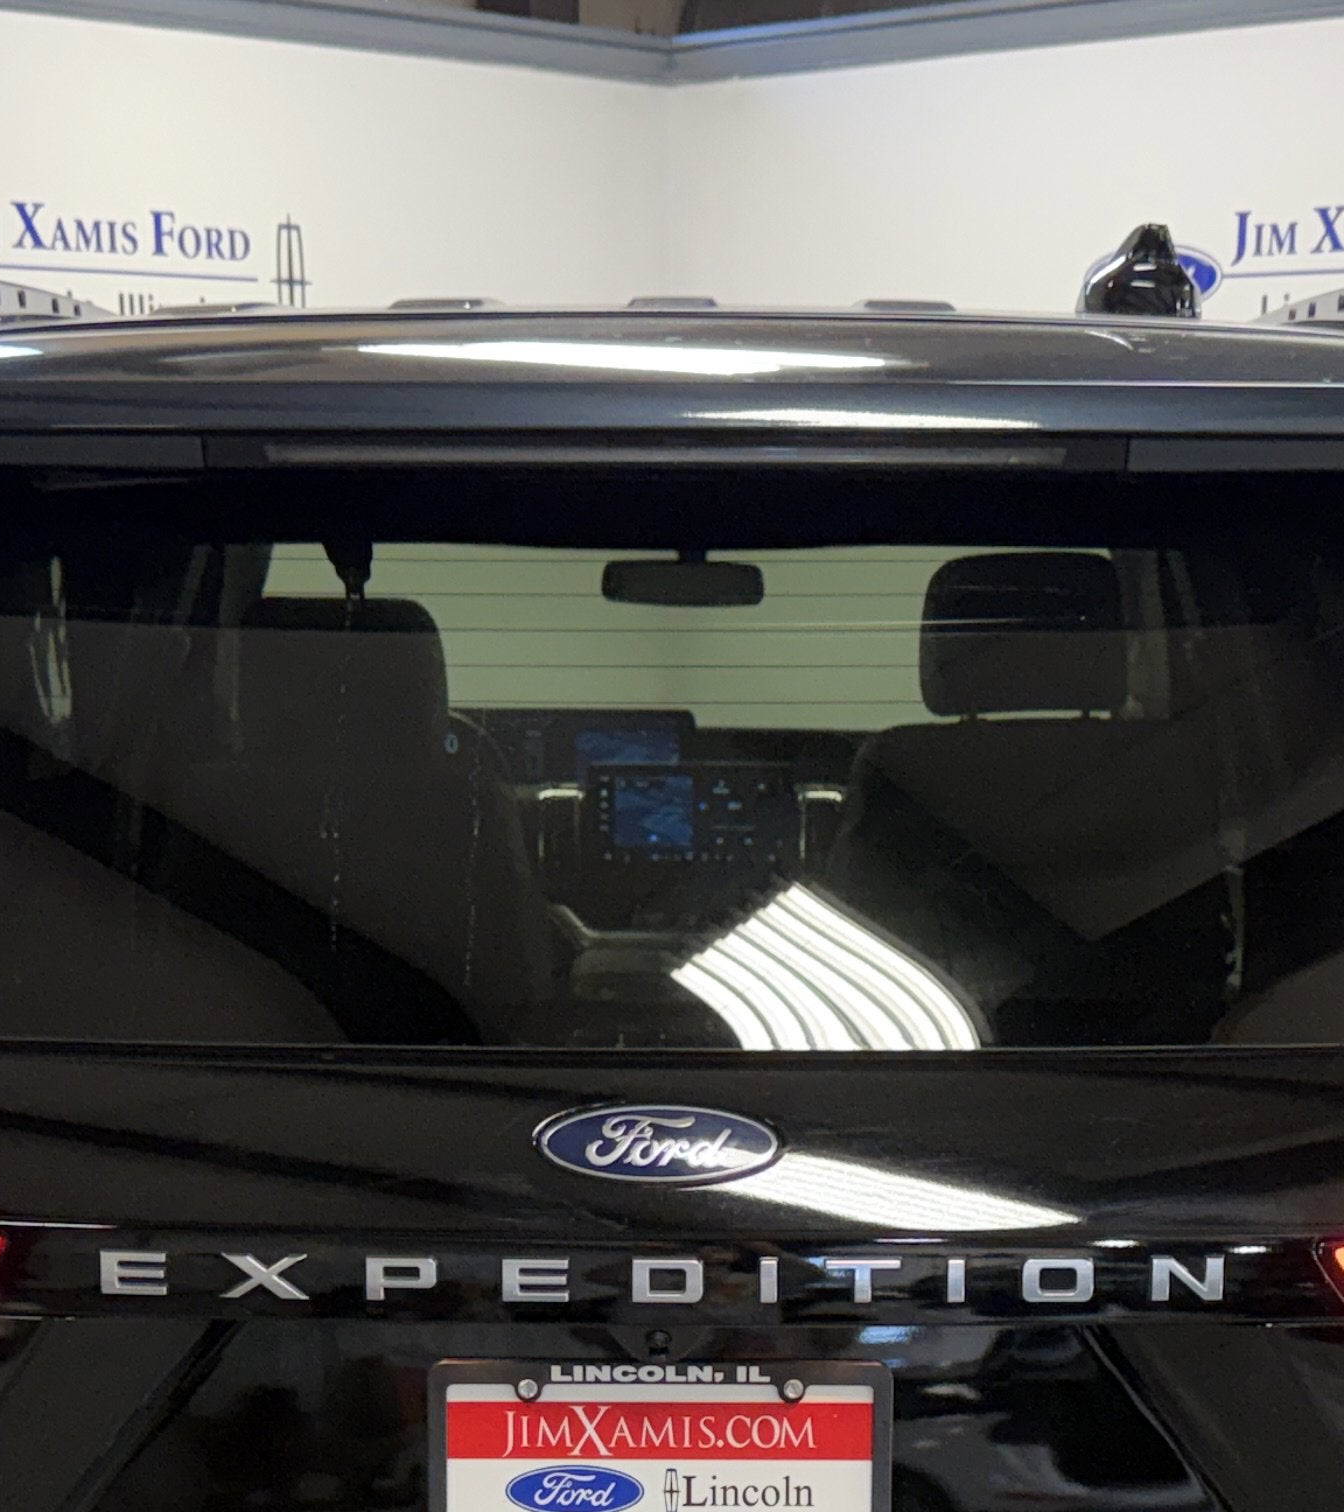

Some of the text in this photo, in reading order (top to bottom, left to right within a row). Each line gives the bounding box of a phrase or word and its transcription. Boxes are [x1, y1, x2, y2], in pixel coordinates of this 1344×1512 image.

[10, 201, 139, 255] XAMIS
[150, 210, 251, 261] FORD
[1230, 211, 1298, 267] JIM
[585, 1114, 732, 1168] Ford
[99, 1247, 1226, 1304] EXPEDITION
[550, 1365, 771, 1383] LINCOLN, IL
[502, 1405, 816, 1458] JIMXAMIS.COM
[534, 1472, 616, 1508] Ford
[682, 1475, 815, 1507] Lincoln
